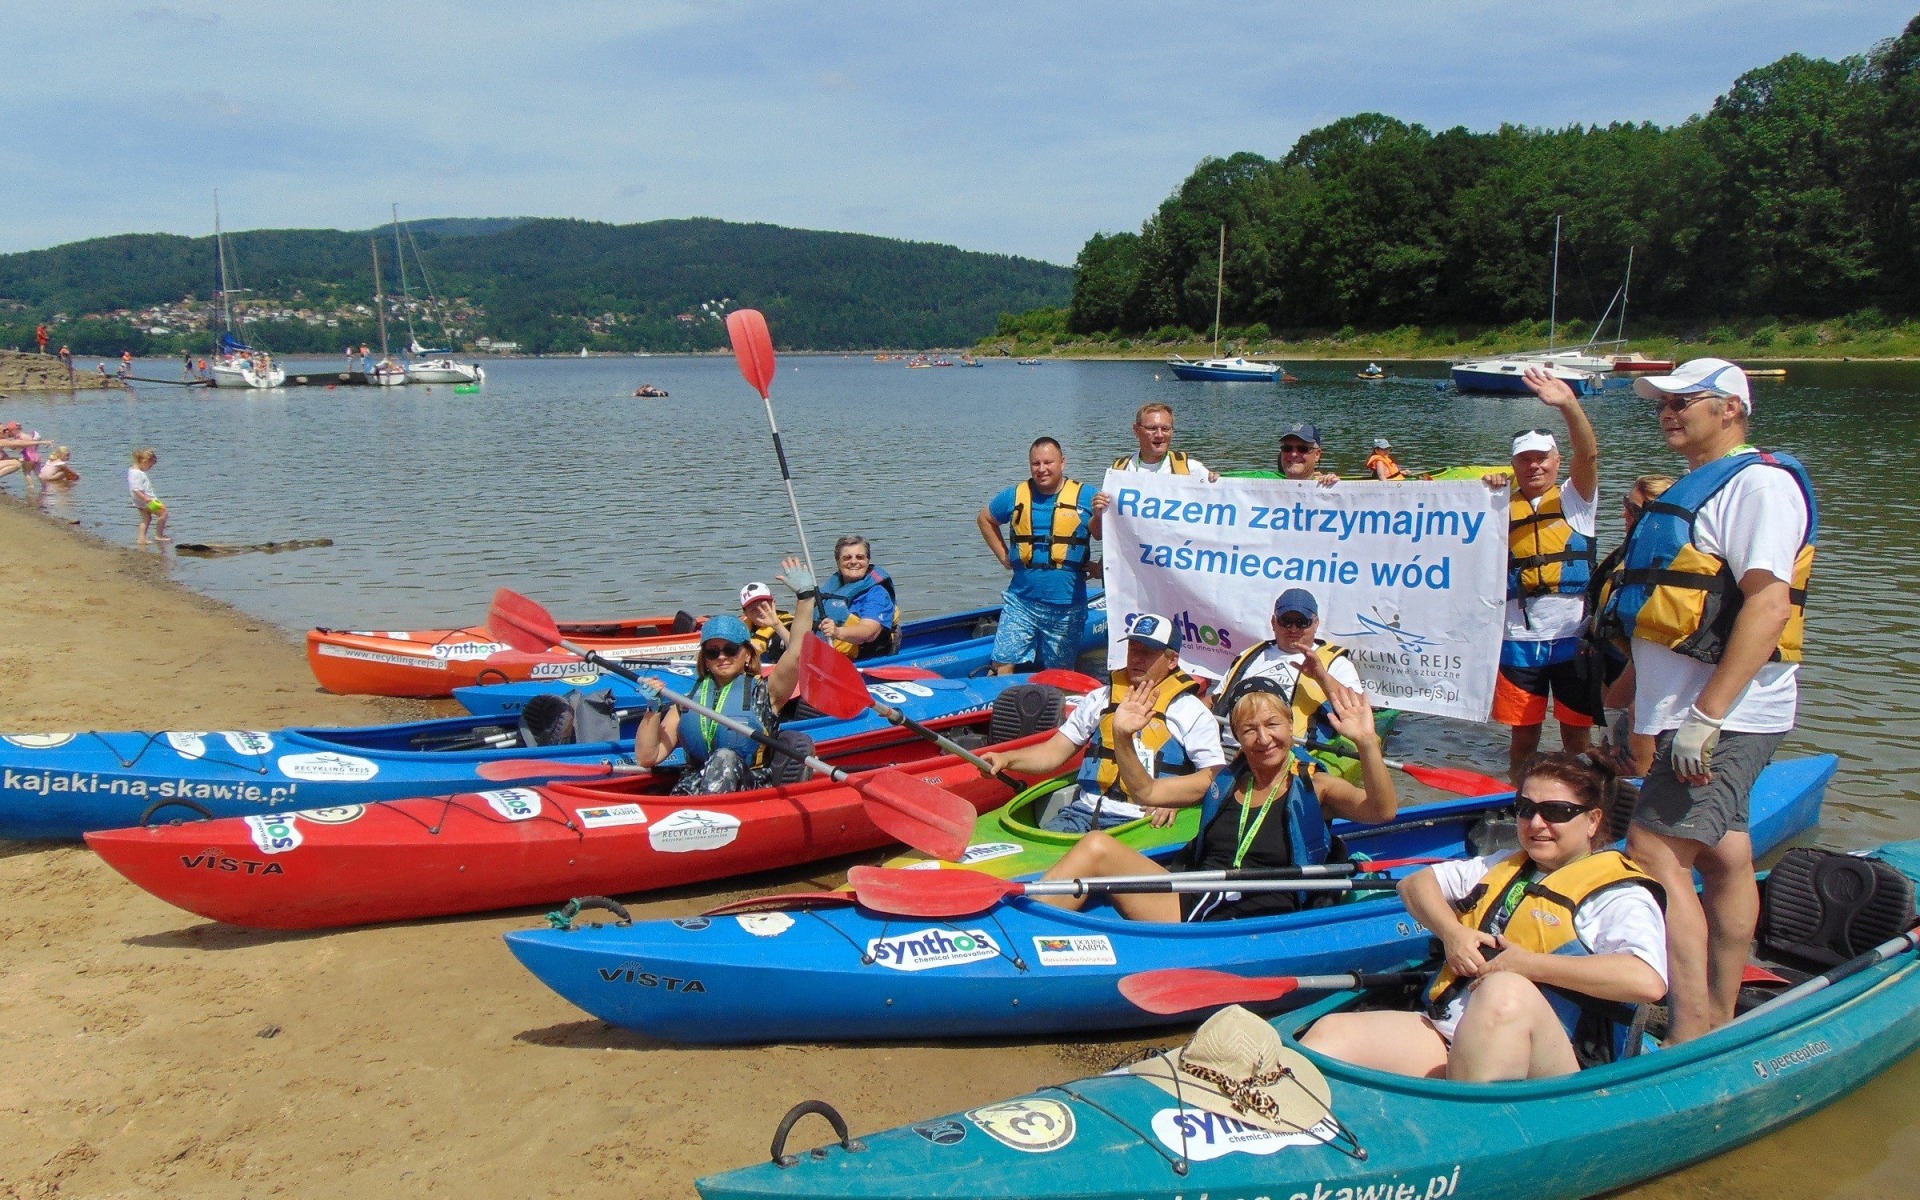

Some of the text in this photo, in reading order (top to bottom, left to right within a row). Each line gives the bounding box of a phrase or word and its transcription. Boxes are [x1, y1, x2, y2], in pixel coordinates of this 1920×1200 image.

[1117, 488, 1486, 545] Razem zatrzymajmy
[1138, 539, 1451, 590] zaśmiecanie wód
[436, 643, 497, 656] synthos
[345, 650, 447, 668] www.recykling-rejs.pl
[1420, 655, 1461, 669] REJS
[531, 661, 600, 678] odzyskuj
[1363, 663, 1460, 679] tworzywa sztuczne
[4, 769, 297, 806] kajaki-na-skawie.pl
[662, 828, 708, 838] RECYKLING
[181, 855, 285, 875] VISTA
[873, 930, 989, 964] synthos
[914, 948, 994, 964] chemical innovations
[599, 968, 707, 993] VISTA
[1769, 1040, 1831, 1075] perception
[1228, 1131, 1271, 1144] chemical
